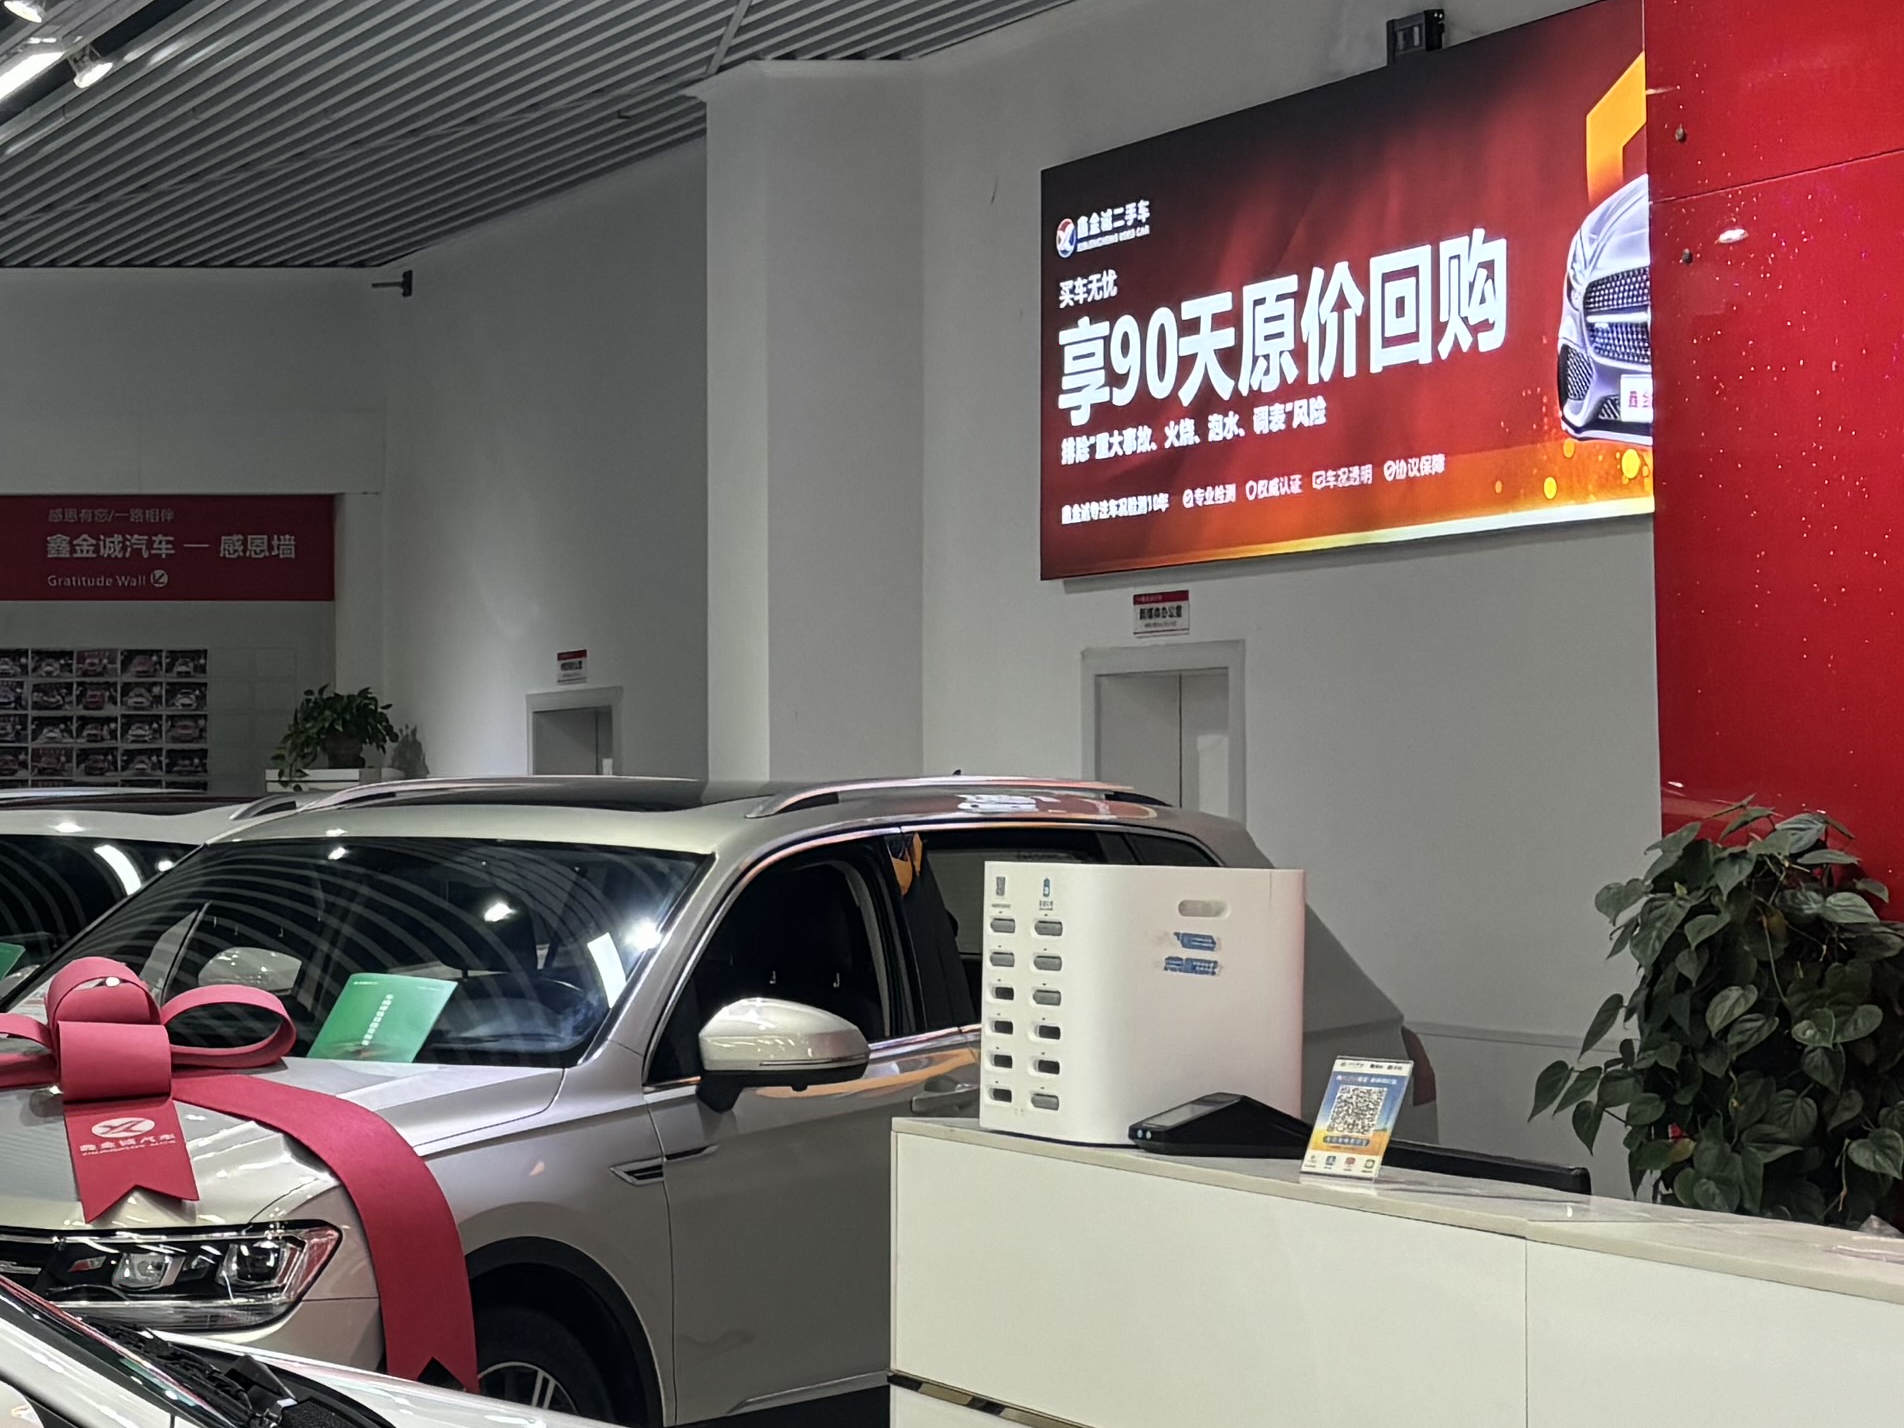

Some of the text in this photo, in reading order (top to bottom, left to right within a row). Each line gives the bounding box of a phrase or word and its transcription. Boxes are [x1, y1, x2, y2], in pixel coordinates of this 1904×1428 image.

[1058, 268, 1118, 309] 买车无忧
[1057, 227, 1508, 428] 享90天原价回购
[1194, 483, 1237, 507] 专业检测
[1394, 453, 1445, 481] 协议保障
[46, 534, 176, 559] 鑫金诚汽车
[219, 534, 296, 559] 感恩墙
[47, 575, 146, 588] Gratitude Wall
